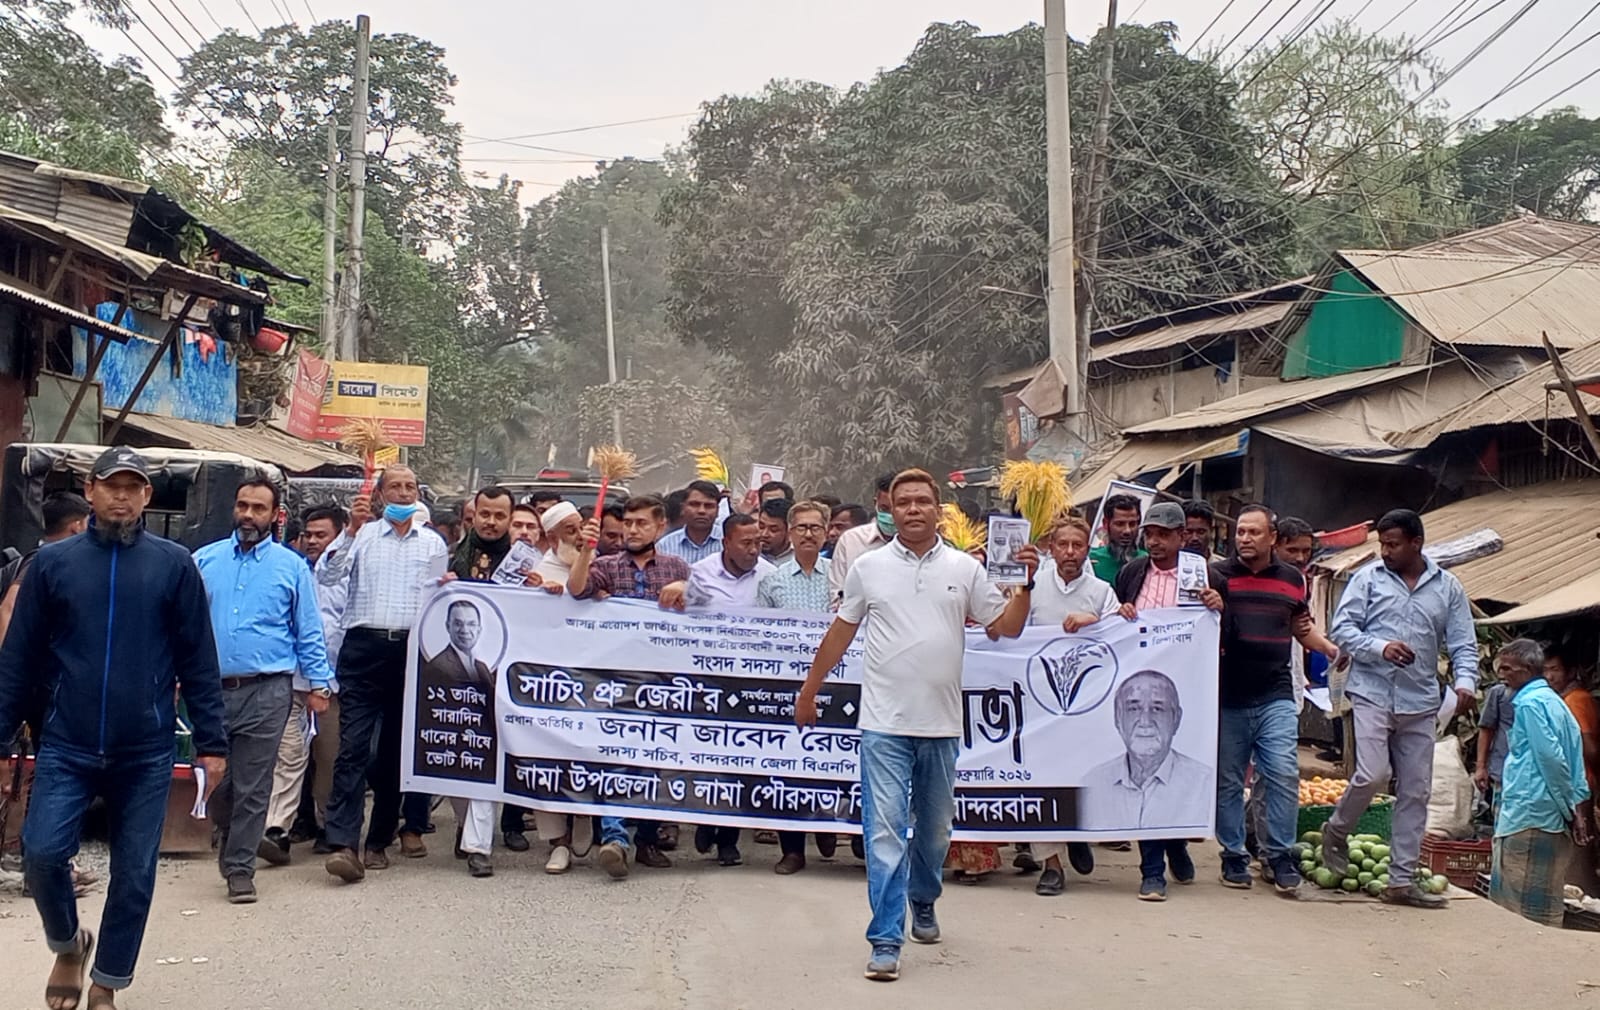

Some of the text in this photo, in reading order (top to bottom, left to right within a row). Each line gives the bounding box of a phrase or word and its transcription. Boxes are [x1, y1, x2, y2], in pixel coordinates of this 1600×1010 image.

[649, 635, 699, 648] বাংলাদেশ
[703, 638, 772, 651] জাতীয়তাবাদী
[692, 654, 735, 672] সংসদ
[741, 658, 783, 675] সদস্য
[427, 686, 487, 706] ১২ তারিখ
[518, 671, 587, 708] সাচিং
[592, 680, 628, 708] প্রু
[431, 707, 483, 727] সারাদিন
[758, 704, 778, 715] লামা
[504, 714, 534, 727] প্রধান
[537, 717, 573, 730] অতিথি
[420, 729, 492, 750] ধানের শীষে
[598, 716, 861, 754] জনাব জাবেদ রেজ
[425, 749, 485, 771] ভোট দিন
[598, 745, 858, 774] সদস্য সচিব, বান্দরবান জেলা বিএনপি
[999, 770, 1032, 781] ২০২৬
[514, 764, 564, 793] লামা
[568, 762, 662, 802] উপজেলা
[668, 779, 685, 800] ও
[693, 778, 745, 809] লামা
[751, 777, 844, 815] পৌরসভা
